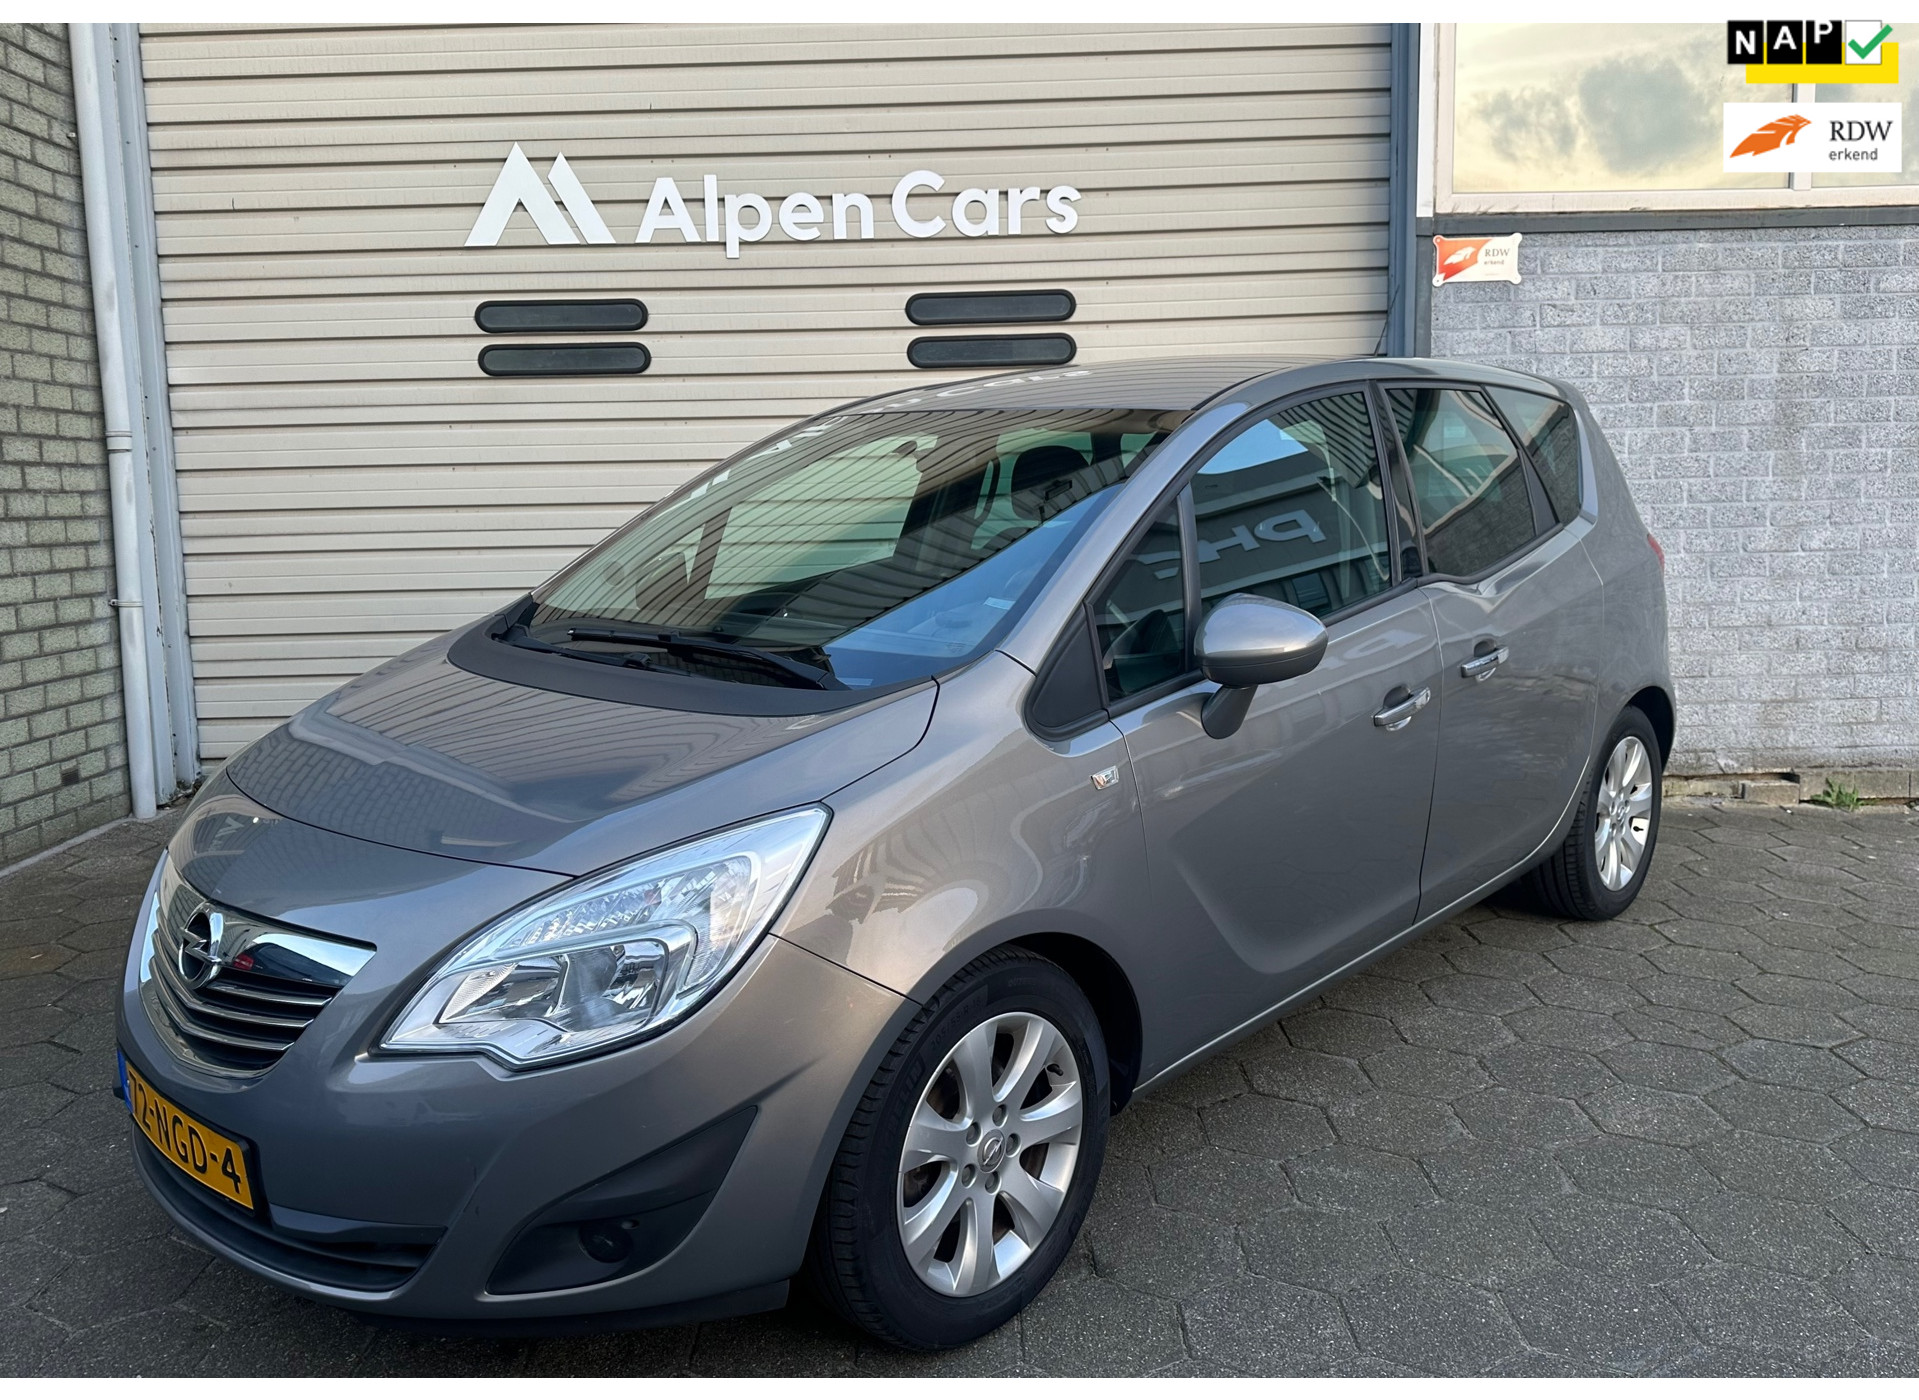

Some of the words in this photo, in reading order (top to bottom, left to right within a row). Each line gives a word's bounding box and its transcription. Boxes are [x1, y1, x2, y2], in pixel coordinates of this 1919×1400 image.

[635, 174, 874, 258] Alpen
[892, 169, 1082, 238] Cars
[1485, 248, 1510, 257] RDW
[128, 1070, 241, 1195] 72-NGD-4
